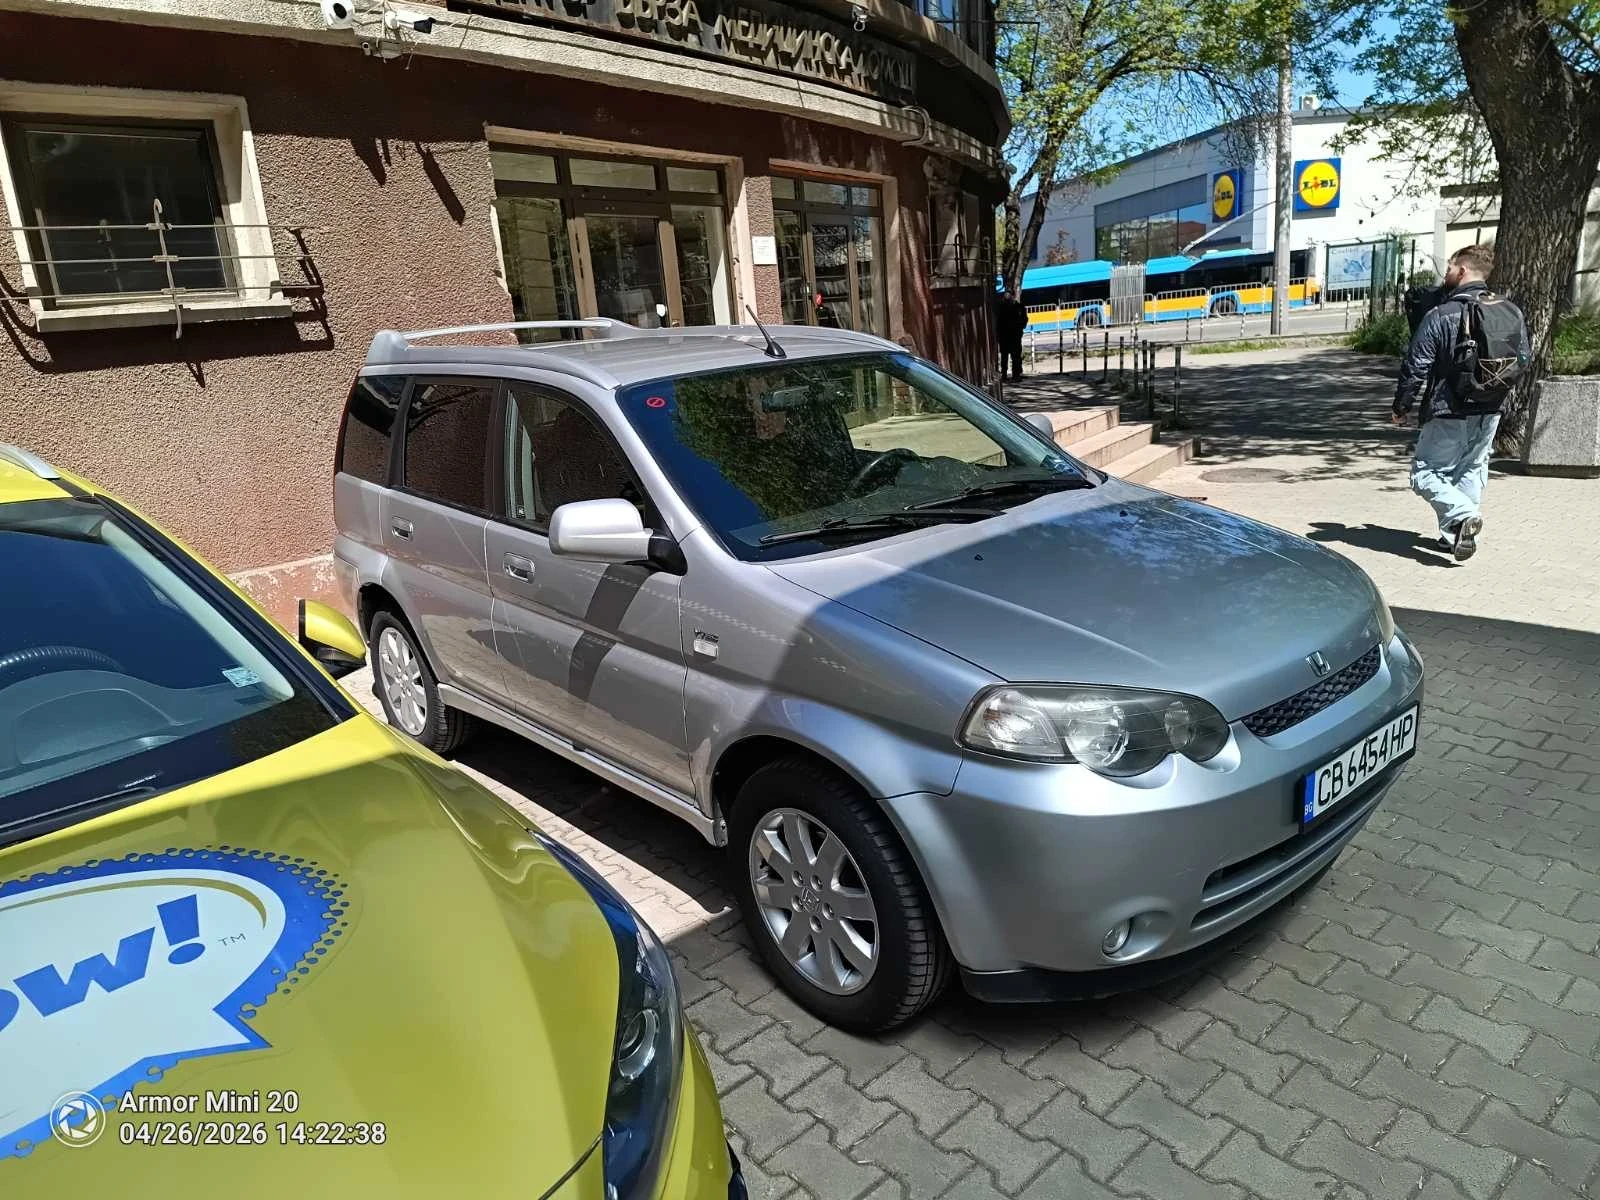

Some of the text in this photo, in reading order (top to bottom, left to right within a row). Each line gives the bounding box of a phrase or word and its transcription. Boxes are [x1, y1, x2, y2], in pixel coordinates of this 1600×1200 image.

[714, 14, 856, 71] МЕДИЦИНСКА
[1347, 729, 1389, 788] 6454
[1304, 801, 1313, 815] BG
[218, 932, 246, 947] TM
